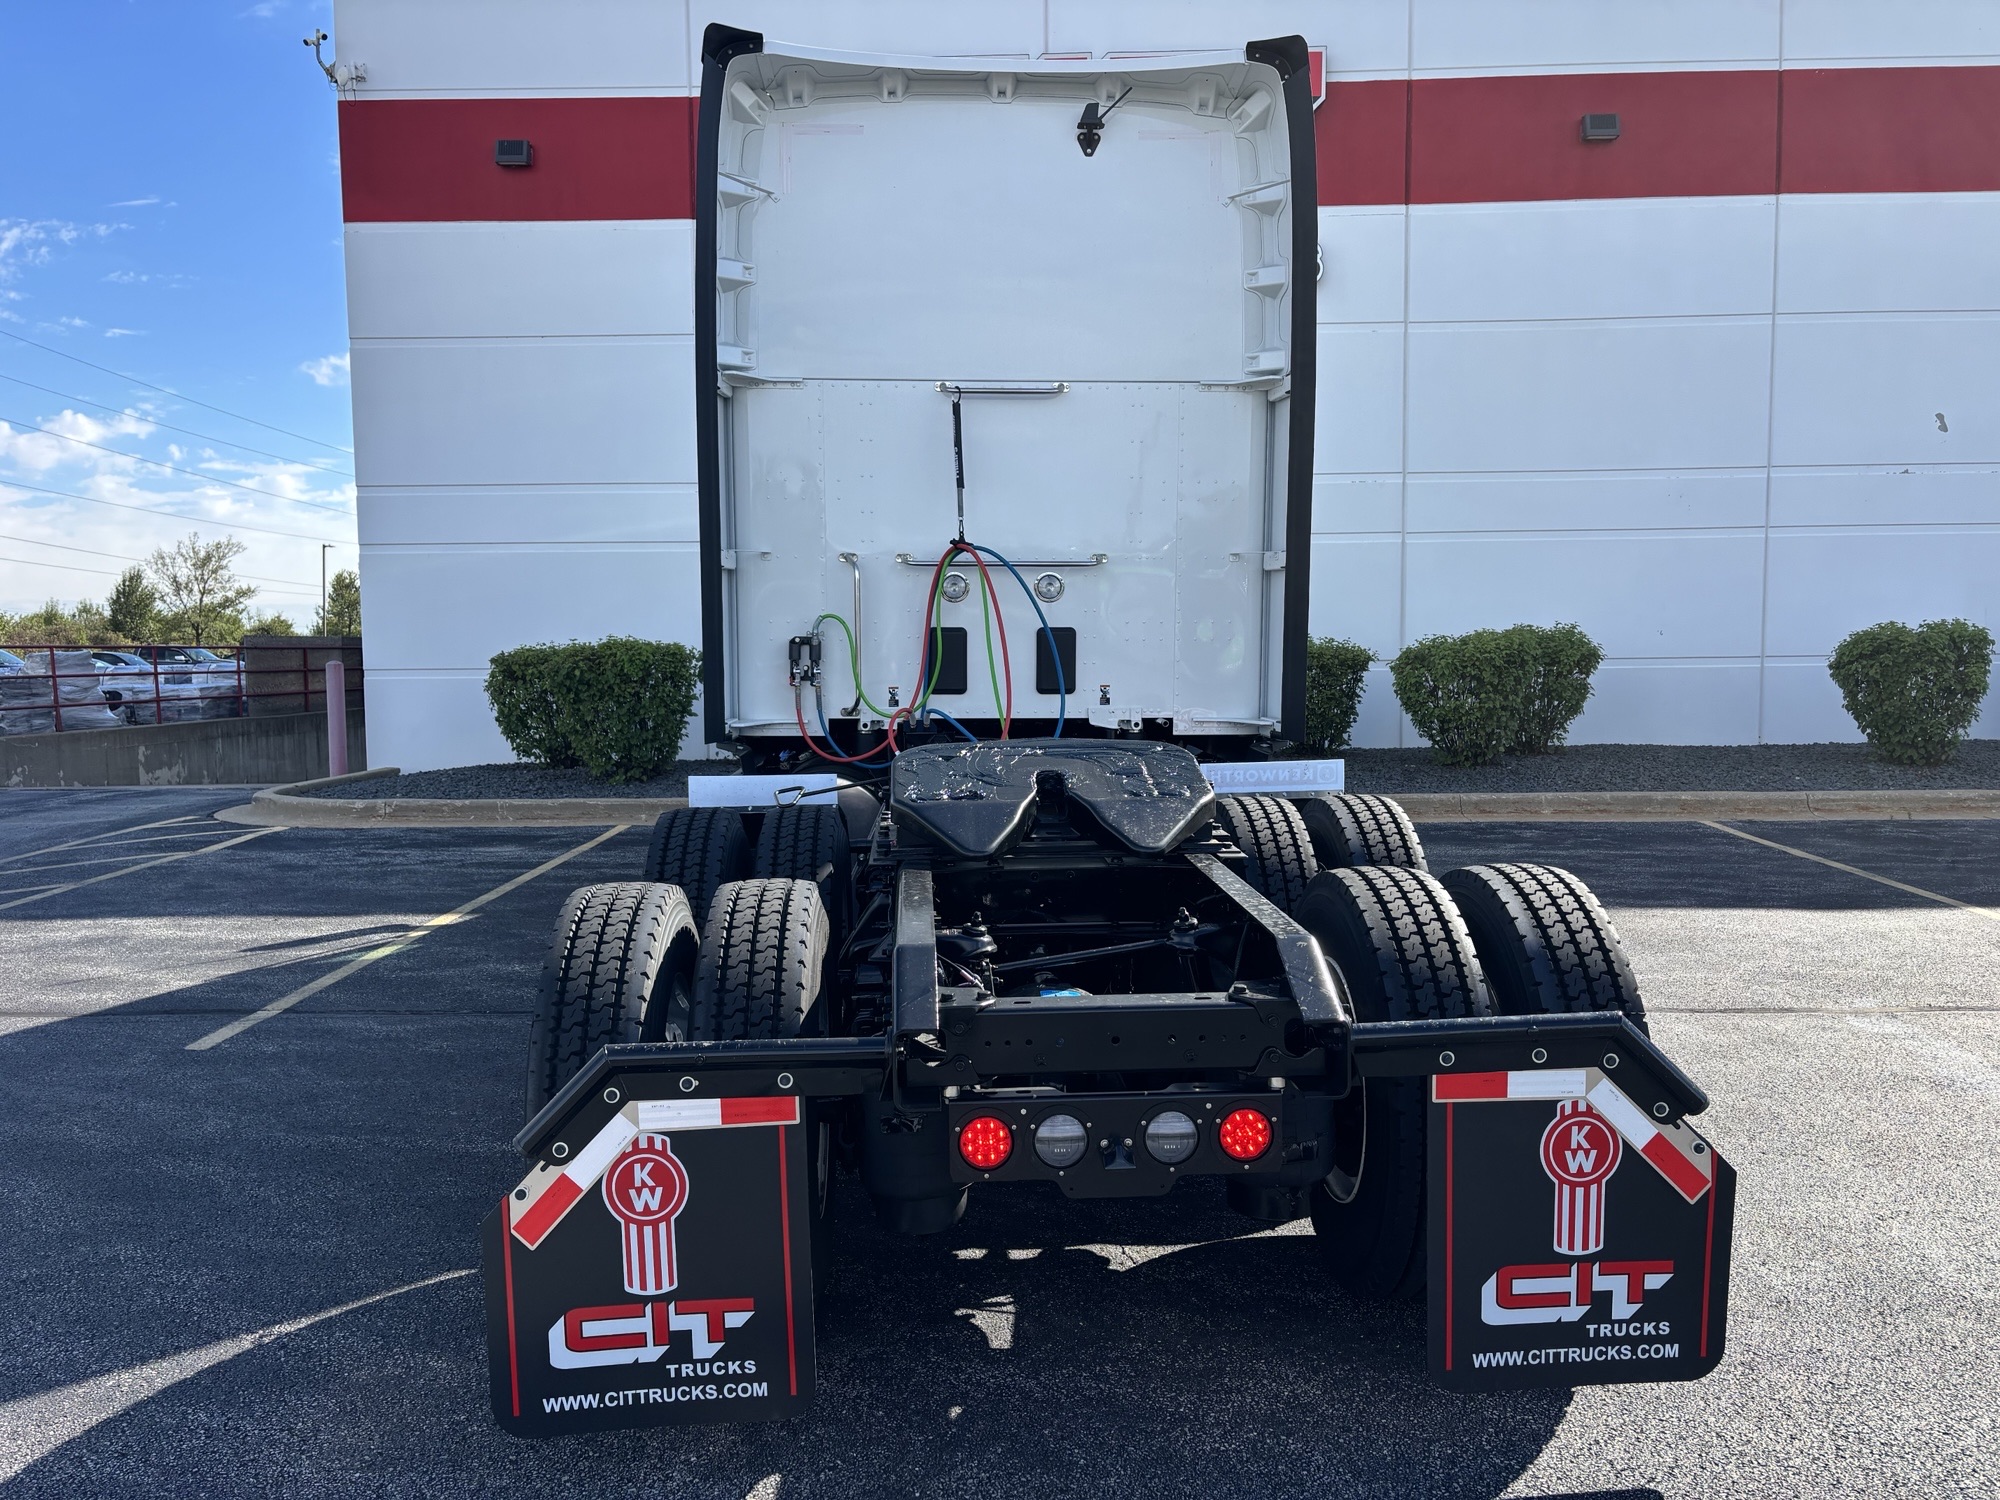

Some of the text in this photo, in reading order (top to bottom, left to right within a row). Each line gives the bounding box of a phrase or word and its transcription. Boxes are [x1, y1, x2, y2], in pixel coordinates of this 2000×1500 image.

[1570, 1125, 1591, 1149] K
[1564, 1149, 1598, 1174] W
[634, 1162, 654, 1187] K
[628, 1187, 663, 1213] W
[1481, 1260, 1674, 1324] CIT
[548, 1297, 755, 1369] CIT
[1586, 1321, 1670, 1338] TRUCKS
[1472, 1343, 1679, 1369] WWW.CITTRUCKS.COM
[666, 1360, 757, 1378] TRUCKS
[542, 1382, 768, 1414] WWW.CITTRUCKS.COM
